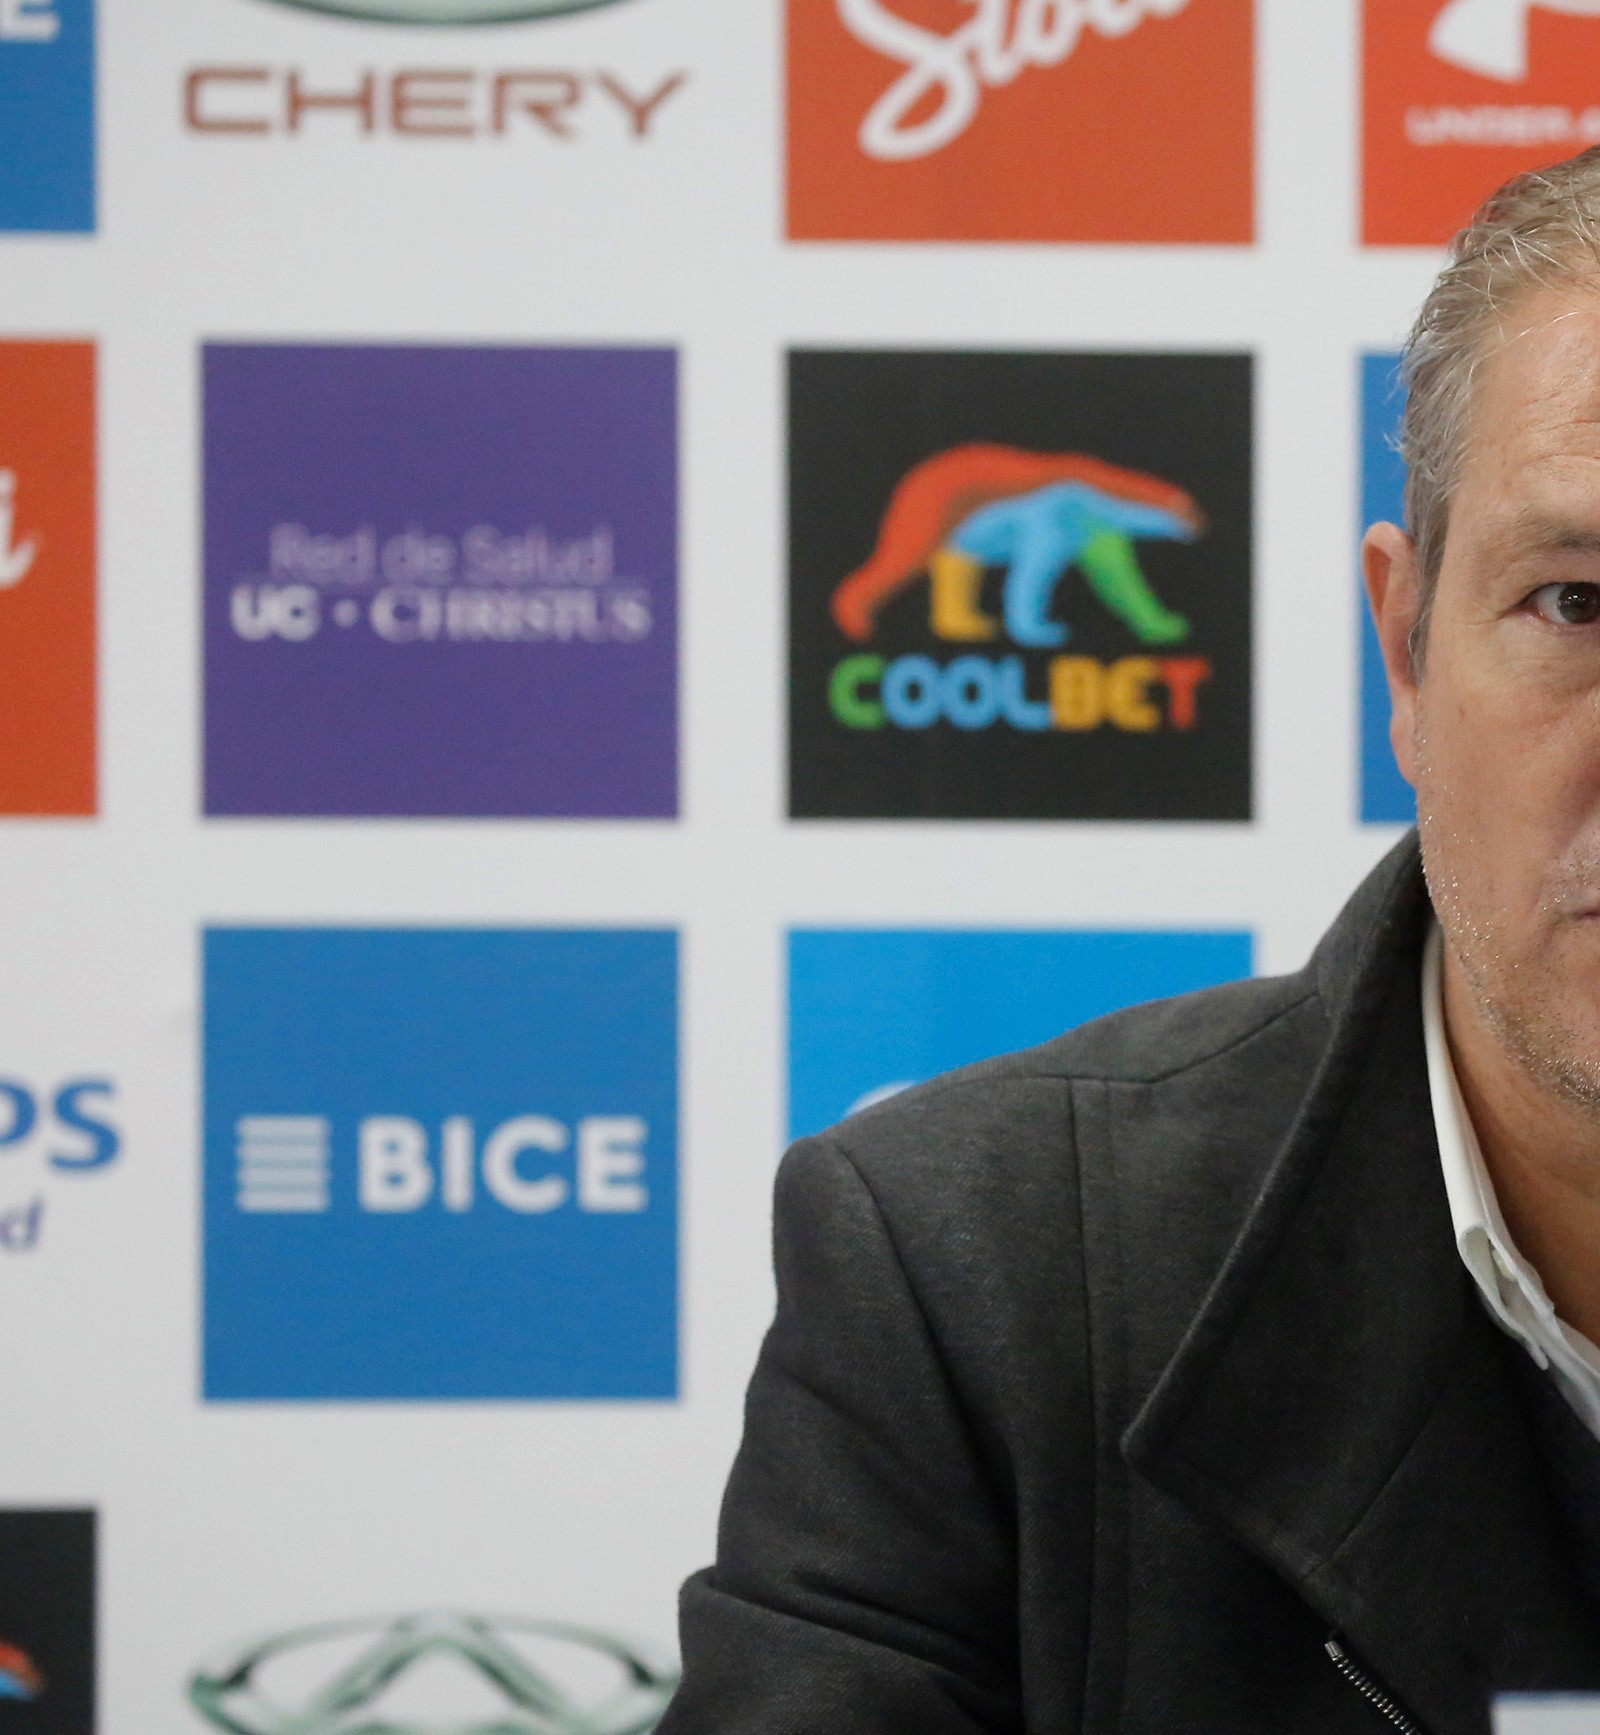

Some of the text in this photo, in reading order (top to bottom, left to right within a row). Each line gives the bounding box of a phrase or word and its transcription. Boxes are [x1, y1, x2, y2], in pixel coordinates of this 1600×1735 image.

[183, 65, 688, 139] CHERY
[836, 0, 1192, 161] Sto
[231, 584, 321, 641] UC
[829, 655, 1211, 730] COOLBET
[357, 1115, 649, 1213] BICE
